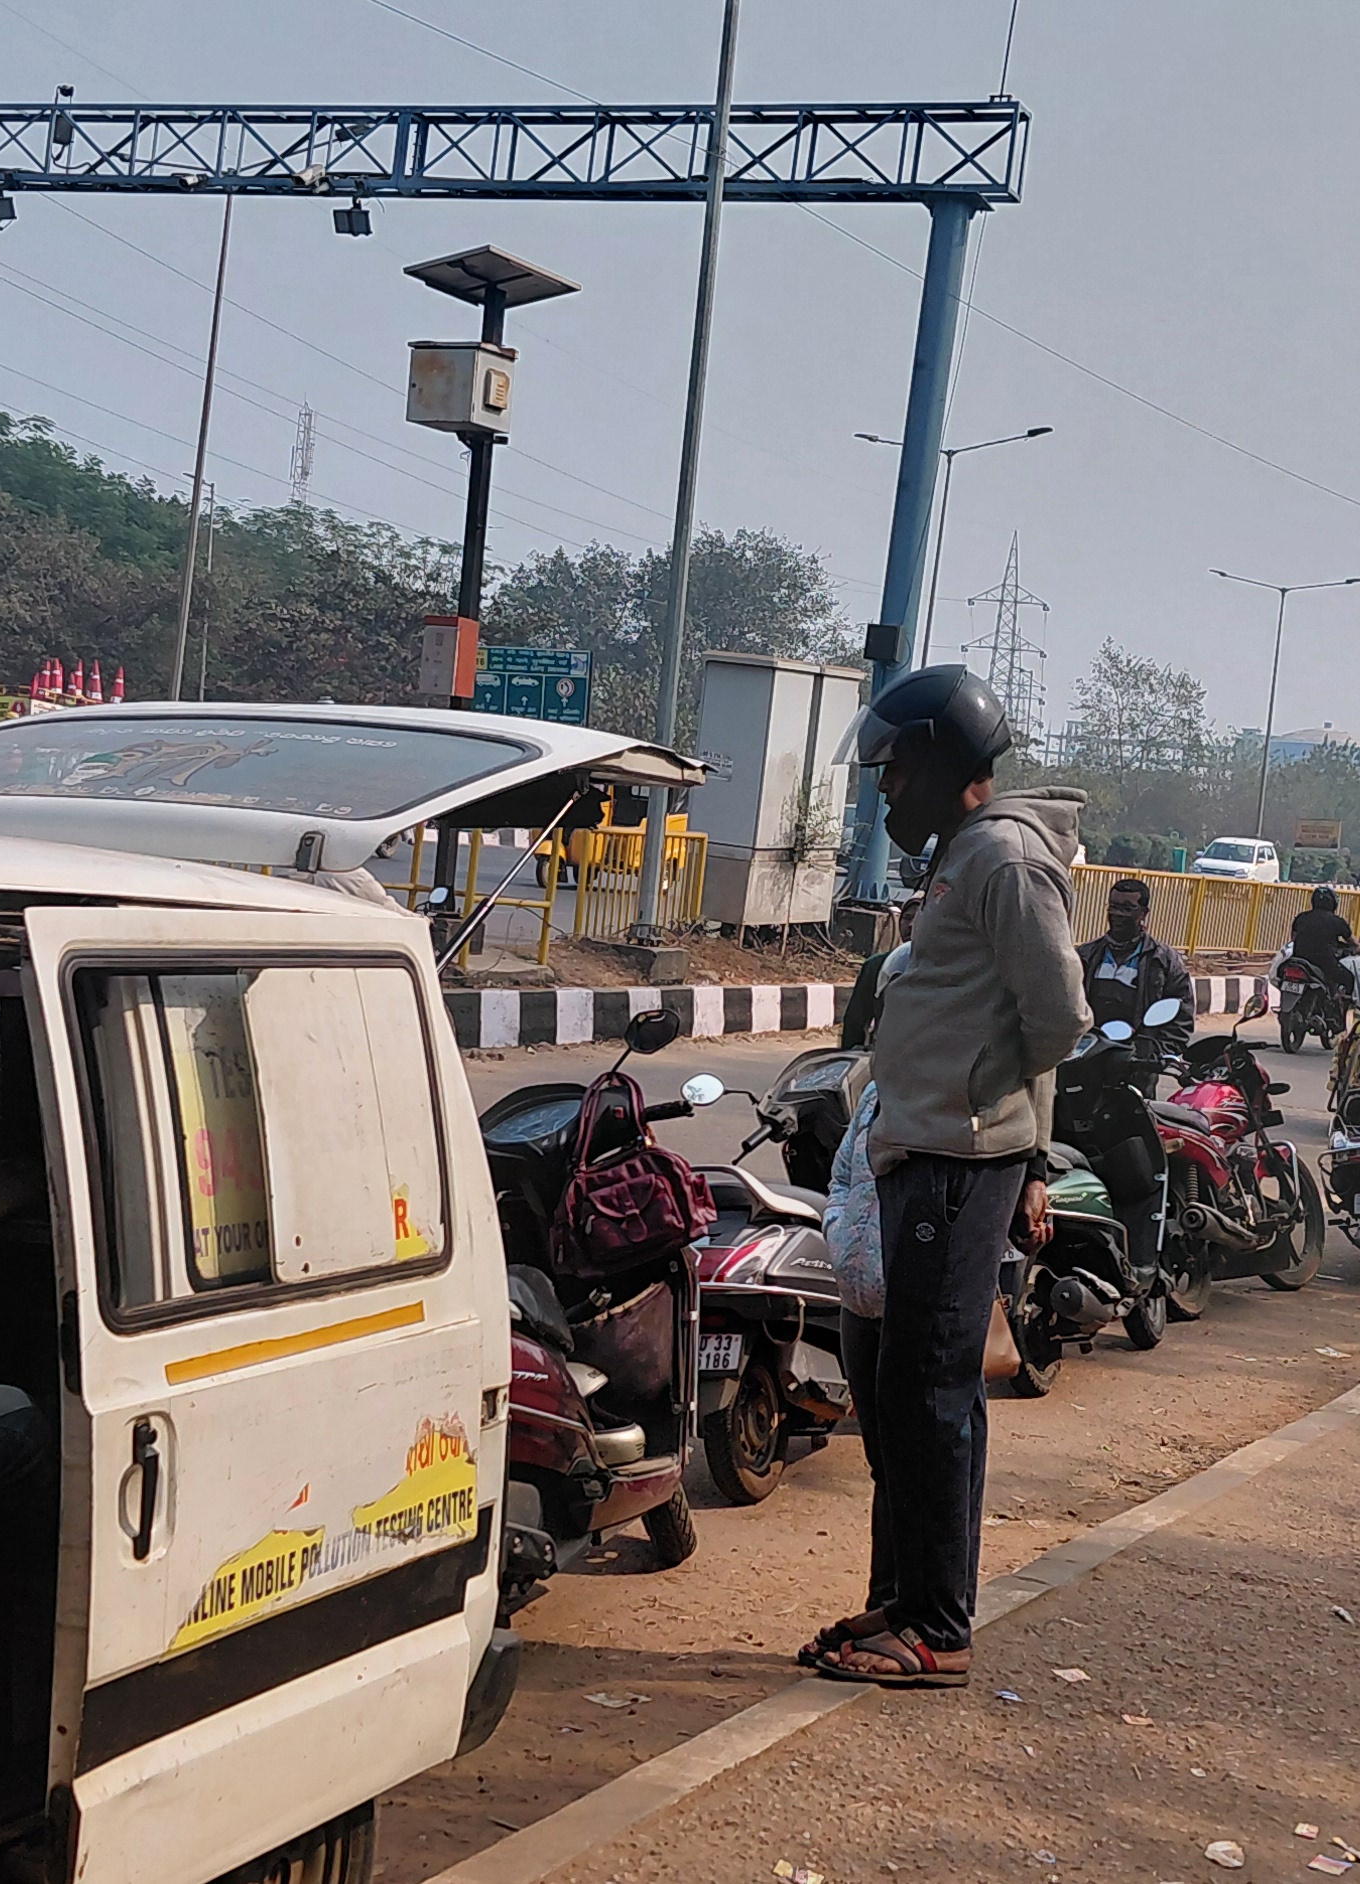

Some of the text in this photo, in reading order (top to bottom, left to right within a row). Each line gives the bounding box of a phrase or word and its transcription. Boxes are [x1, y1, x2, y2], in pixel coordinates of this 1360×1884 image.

[214, 1222, 252, 1256] YOUR
[240, 1550, 297, 1607] MOBILE
[426, 1485, 474, 1533] CENTRE
